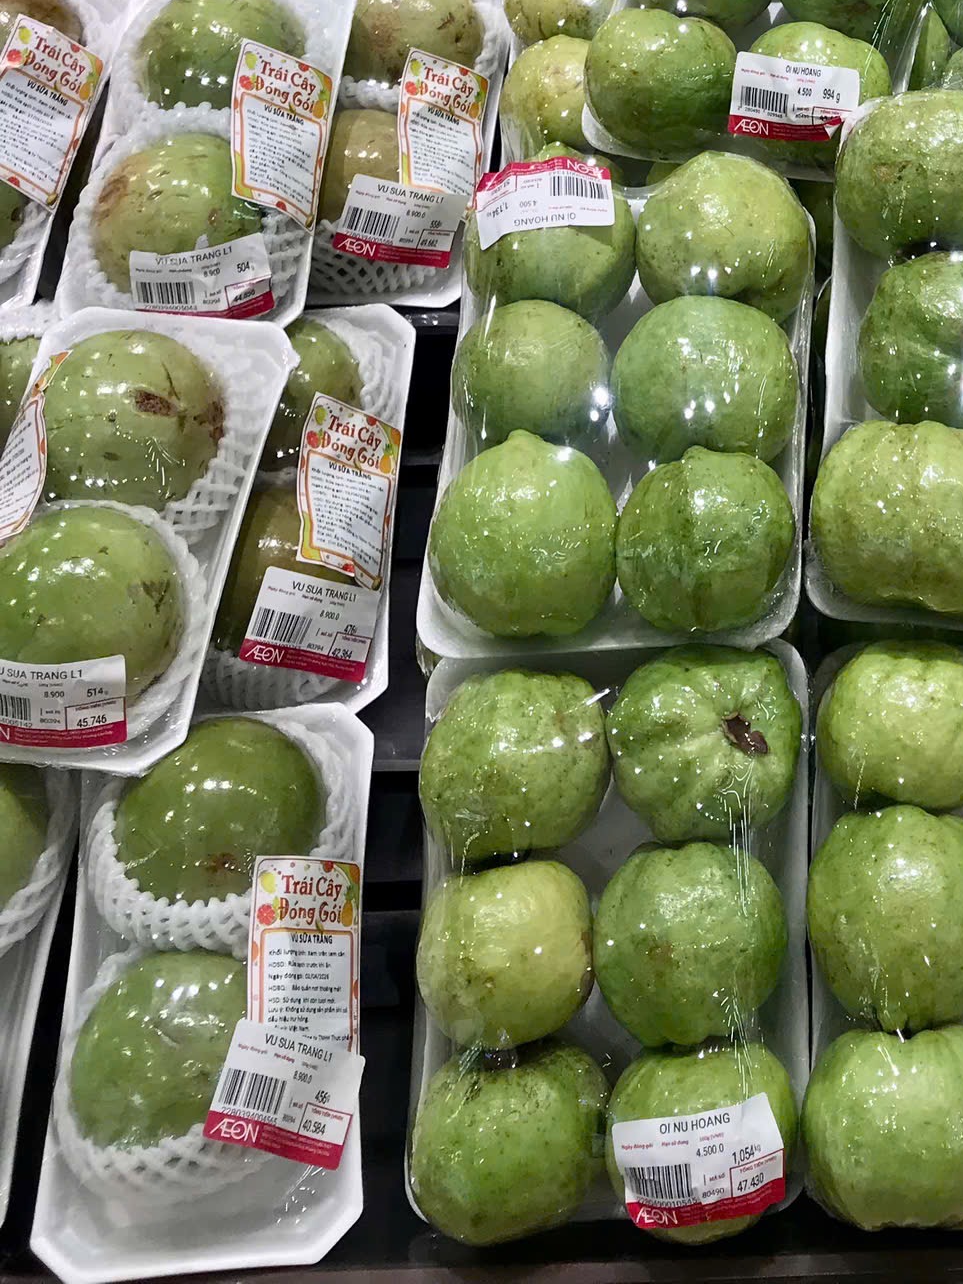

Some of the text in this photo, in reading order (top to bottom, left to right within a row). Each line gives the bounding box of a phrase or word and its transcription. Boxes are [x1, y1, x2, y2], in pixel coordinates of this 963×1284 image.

[35, 35, 86, 77] Trái Cây
[24, 49, 80, 95] Đóng Gói
[260, 59, 316, 94] Trái Cây
[424, 67, 474, 97] Trái Cây
[254, 76, 315, 113] Đóng Gói
[418, 81, 470, 114] Đóng Gói
[734, 119, 769, 135] ÆON
[377, 184, 444, 204] VU SUA TRANG L1
[327, 416, 382, 451] Trái Cây
[321, 431, 380, 469] Đóng Gói
[292, 581, 357, 602] VU SUA TRANG L1
[77, 715, 107, 727] 45.746
[281, 875, 343, 901] Trái Cây
[278, 898, 341, 925] Đóng Gói
[265, 1033, 333, 1062] VU SUA TRANG L1
[210, 1118, 260, 1143] ÆON
[302, 1120, 326, 1136] 40.584
[659, 1113, 731, 1135] OI NU HOANG
[702, 1188, 725, 1198] 80490
[737, 1173, 764, 1192] 47.430
[636, 1208, 678, 1224] ÆON
